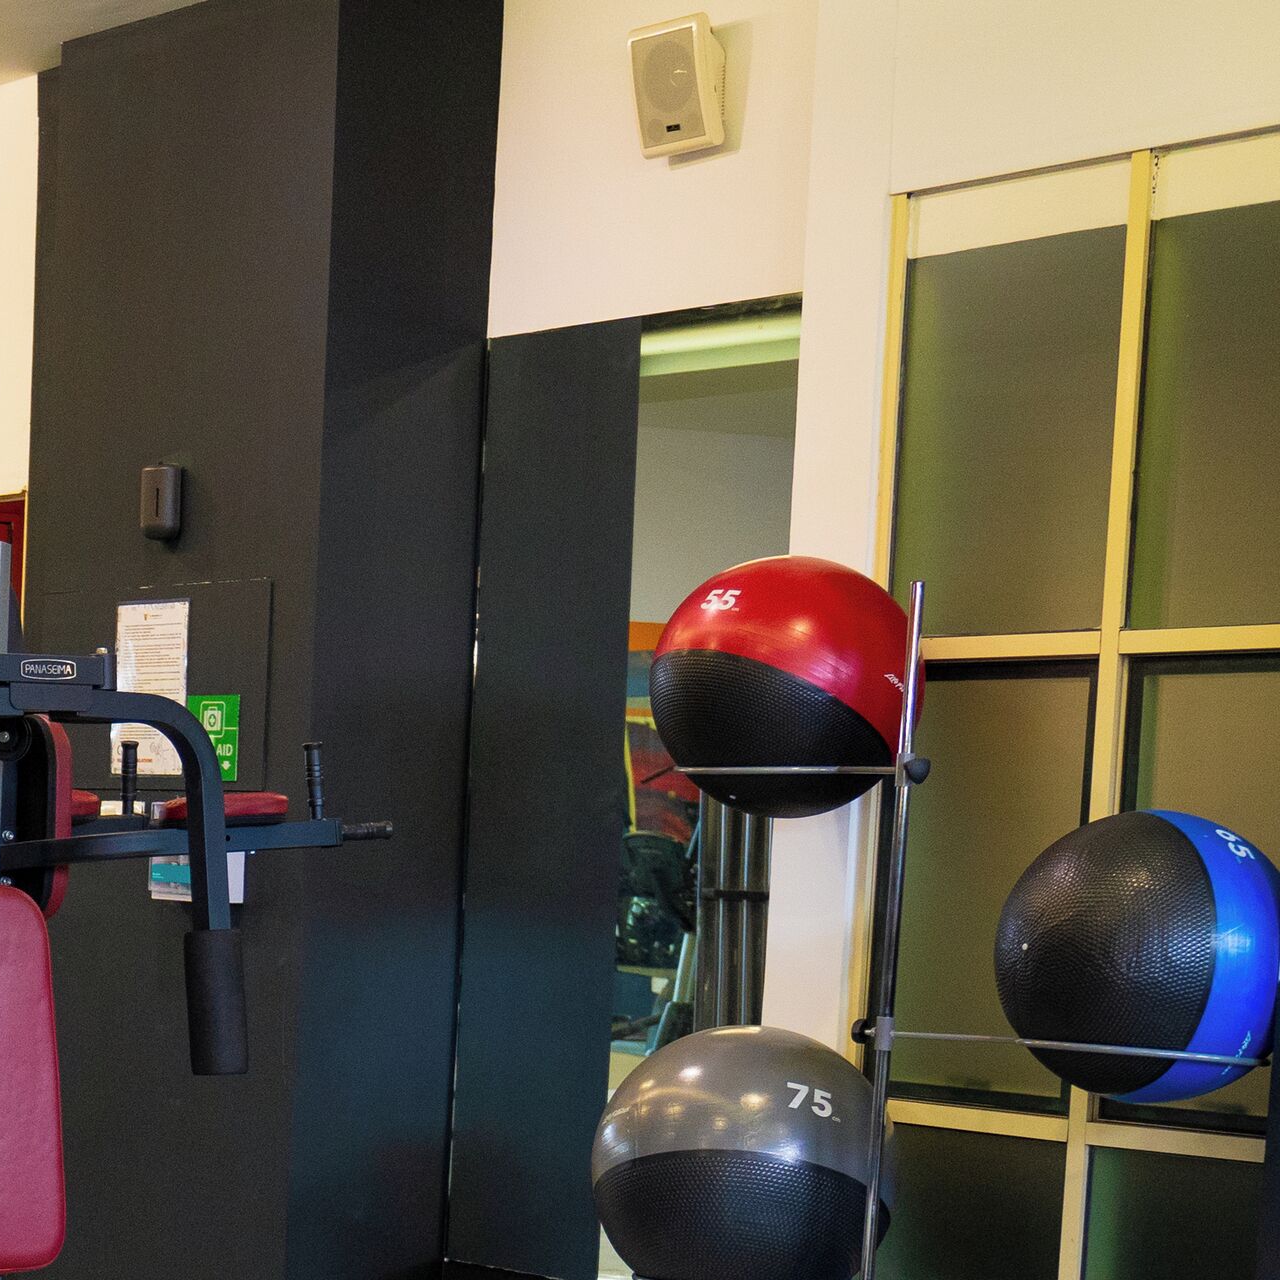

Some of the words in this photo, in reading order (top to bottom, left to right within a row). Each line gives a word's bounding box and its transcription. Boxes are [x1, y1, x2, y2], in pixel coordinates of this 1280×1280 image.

[700, 589, 742, 611] 55
[24, 663, 72, 675] PANASEIMA
[216, 743, 234, 757] AID
[1215, 829, 1255, 860] 65
[786, 1081, 833, 1118] 75
